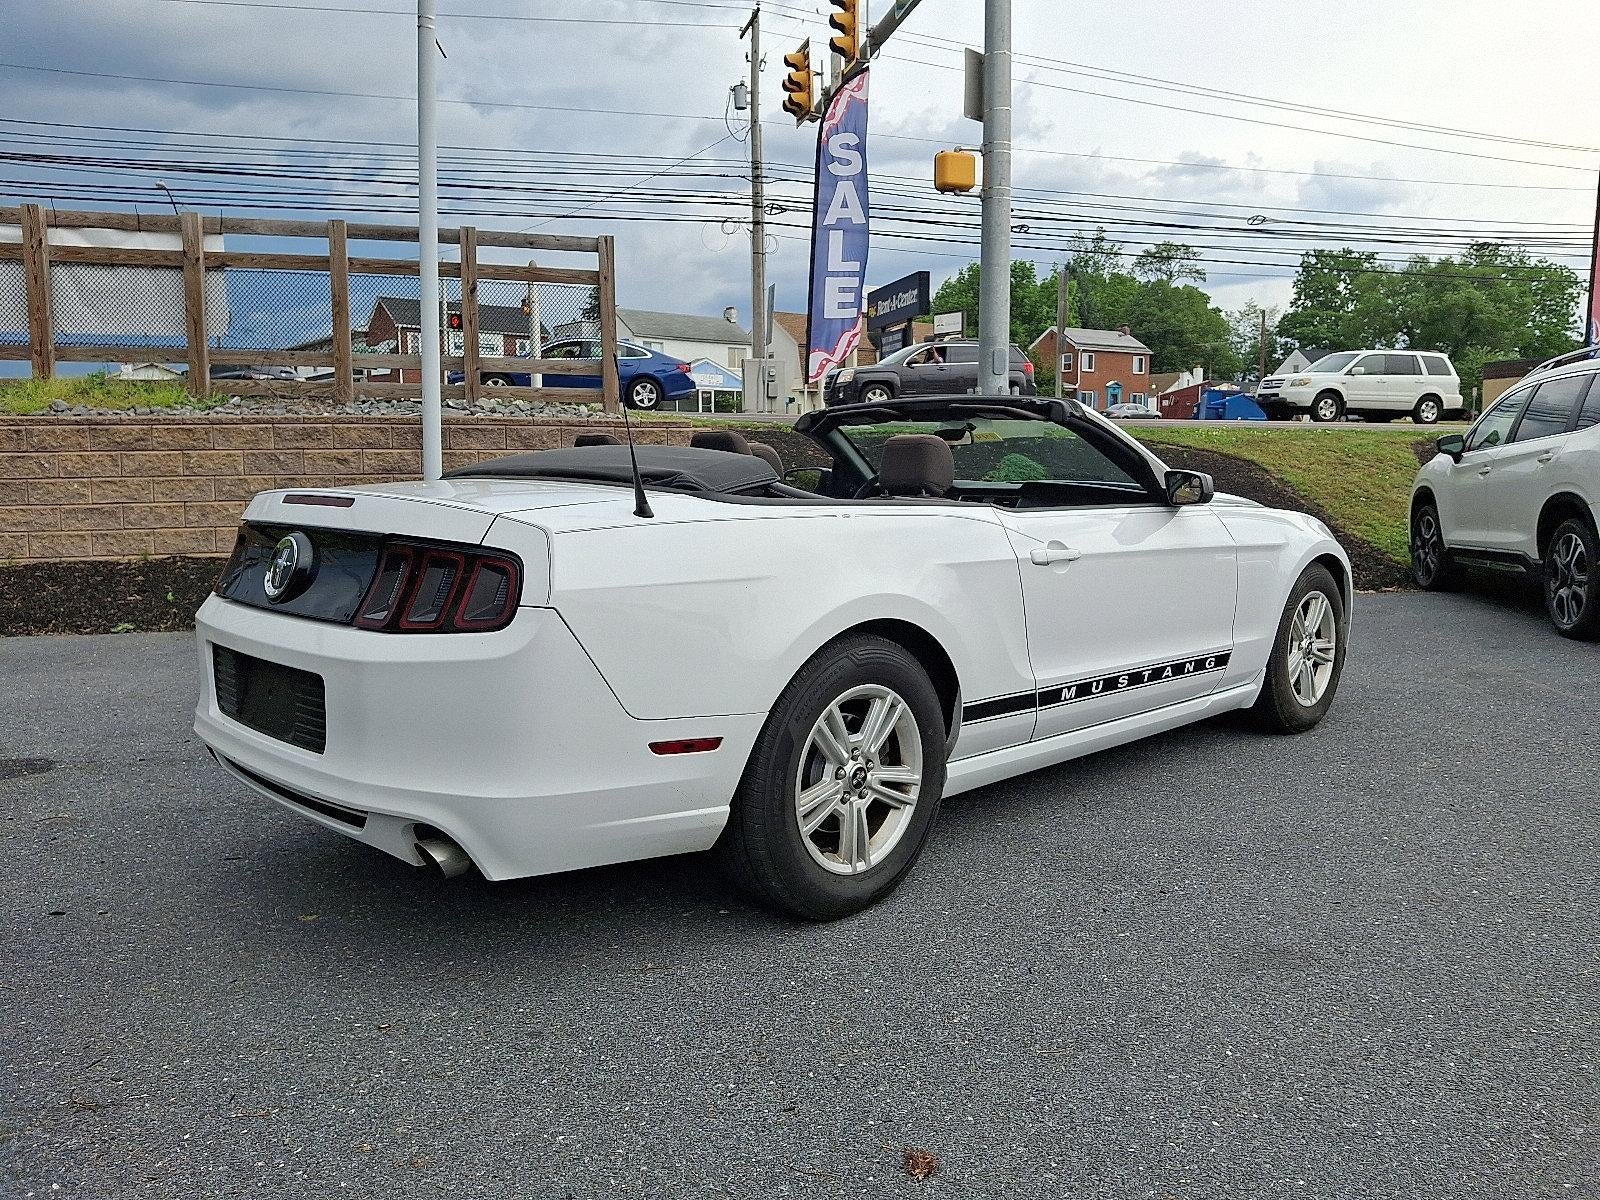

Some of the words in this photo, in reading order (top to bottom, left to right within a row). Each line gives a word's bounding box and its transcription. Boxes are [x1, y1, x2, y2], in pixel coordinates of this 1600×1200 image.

[823, 132, 866, 319] SALE
[876, 288, 918, 316] Rent-A-Center
[1061, 657, 1216, 701] MUSTANG
